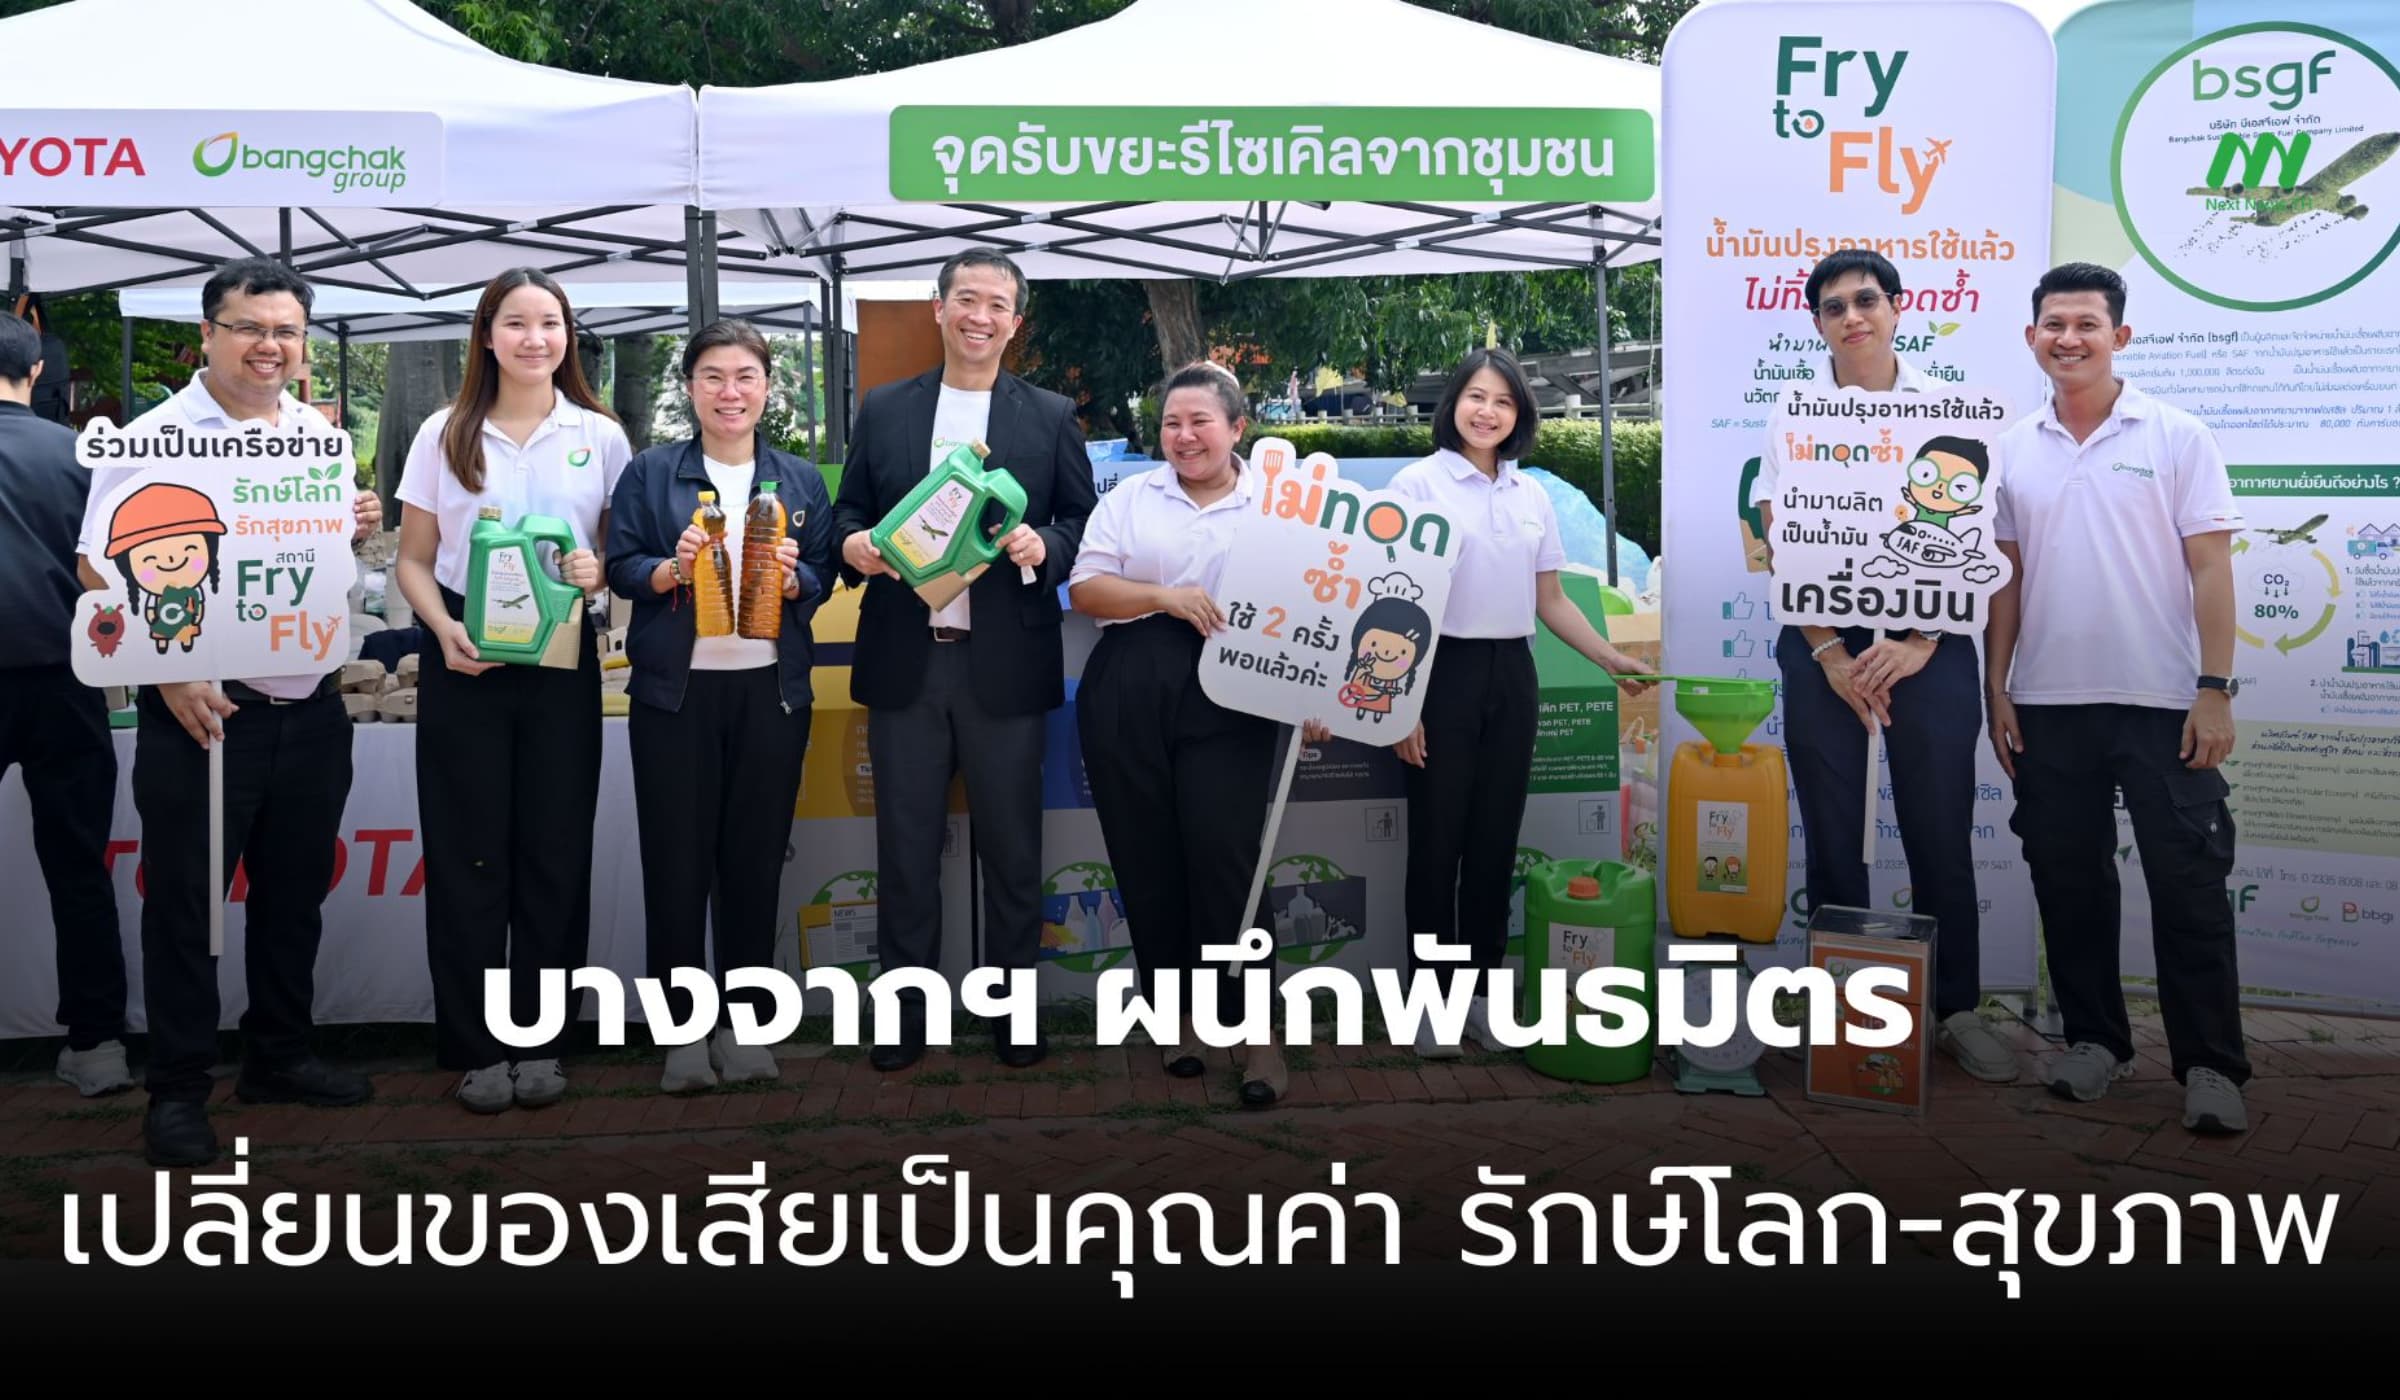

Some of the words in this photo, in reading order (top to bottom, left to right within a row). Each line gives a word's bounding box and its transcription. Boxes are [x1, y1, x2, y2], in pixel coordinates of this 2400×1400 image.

[1776, 36, 1909, 118] Fry
[2193, 50, 2336, 111] bsgf
[1773, 99, 1825, 139] to
[242, 144, 407, 178] bangchak
[932, 119, 1614, 195] จุดรับขยะรีไซเคิลจากชุมชน
[1829, 126, 1945, 216] Fly
[332, 168, 407, 194] group
[1787, 390, 2005, 425] น้ำมันปรุงอาหารใช้แล้ว
[86, 424, 343, 458] ร่วมเป็นเครือข่าย
[232, 474, 342, 503] รักษ์โลก
[1783, 486, 1883, 513] นำมาผลิต
[235, 514, 343, 543] รักสุขภาพ
[1782, 518, 1869, 547] เป็นน้ำมัน
[275, 548, 315, 564] สถานี
[237, 559, 315, 606] Fry
[1303, 540, 1362, 610] ซ้ำ
[1781, 557, 1975, 623] เครื่องบิน
[236, 597, 268, 623] to
[1227, 600, 1258, 630] ใช้
[1261, 606, 1287, 638] 2
[1292, 615, 1340, 652] ครั้ง
[2254, 603, 2299, 620] 80%
[270, 611, 338, 661] Fly
[1218, 646, 1329, 689] พอแล้วค่ะ
[1586, 701, 1614, 712] PETE
[1709, 811, 1729, 825] Fry
[1716, 825, 1735, 839] Fly
[1563, 930, 1589, 949] Fry
[1572, 952, 1597, 969] Fly
